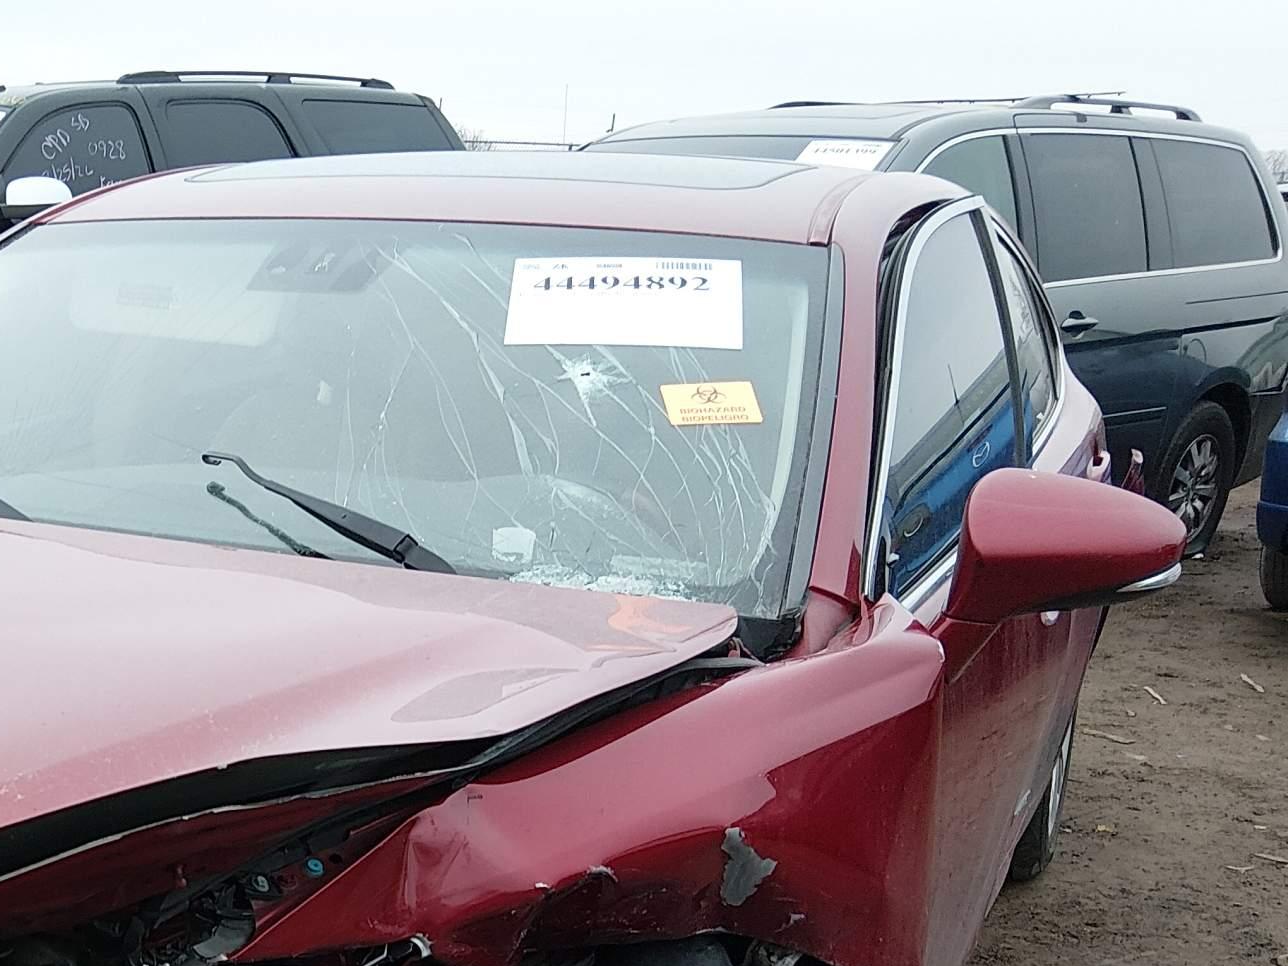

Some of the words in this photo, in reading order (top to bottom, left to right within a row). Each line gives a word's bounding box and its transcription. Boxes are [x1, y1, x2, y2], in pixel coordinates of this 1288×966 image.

[88, 139, 126, 160] 0928
[533, 275, 711, 292] 44494892
[679, 405, 747, 415] BIOHAZARD
